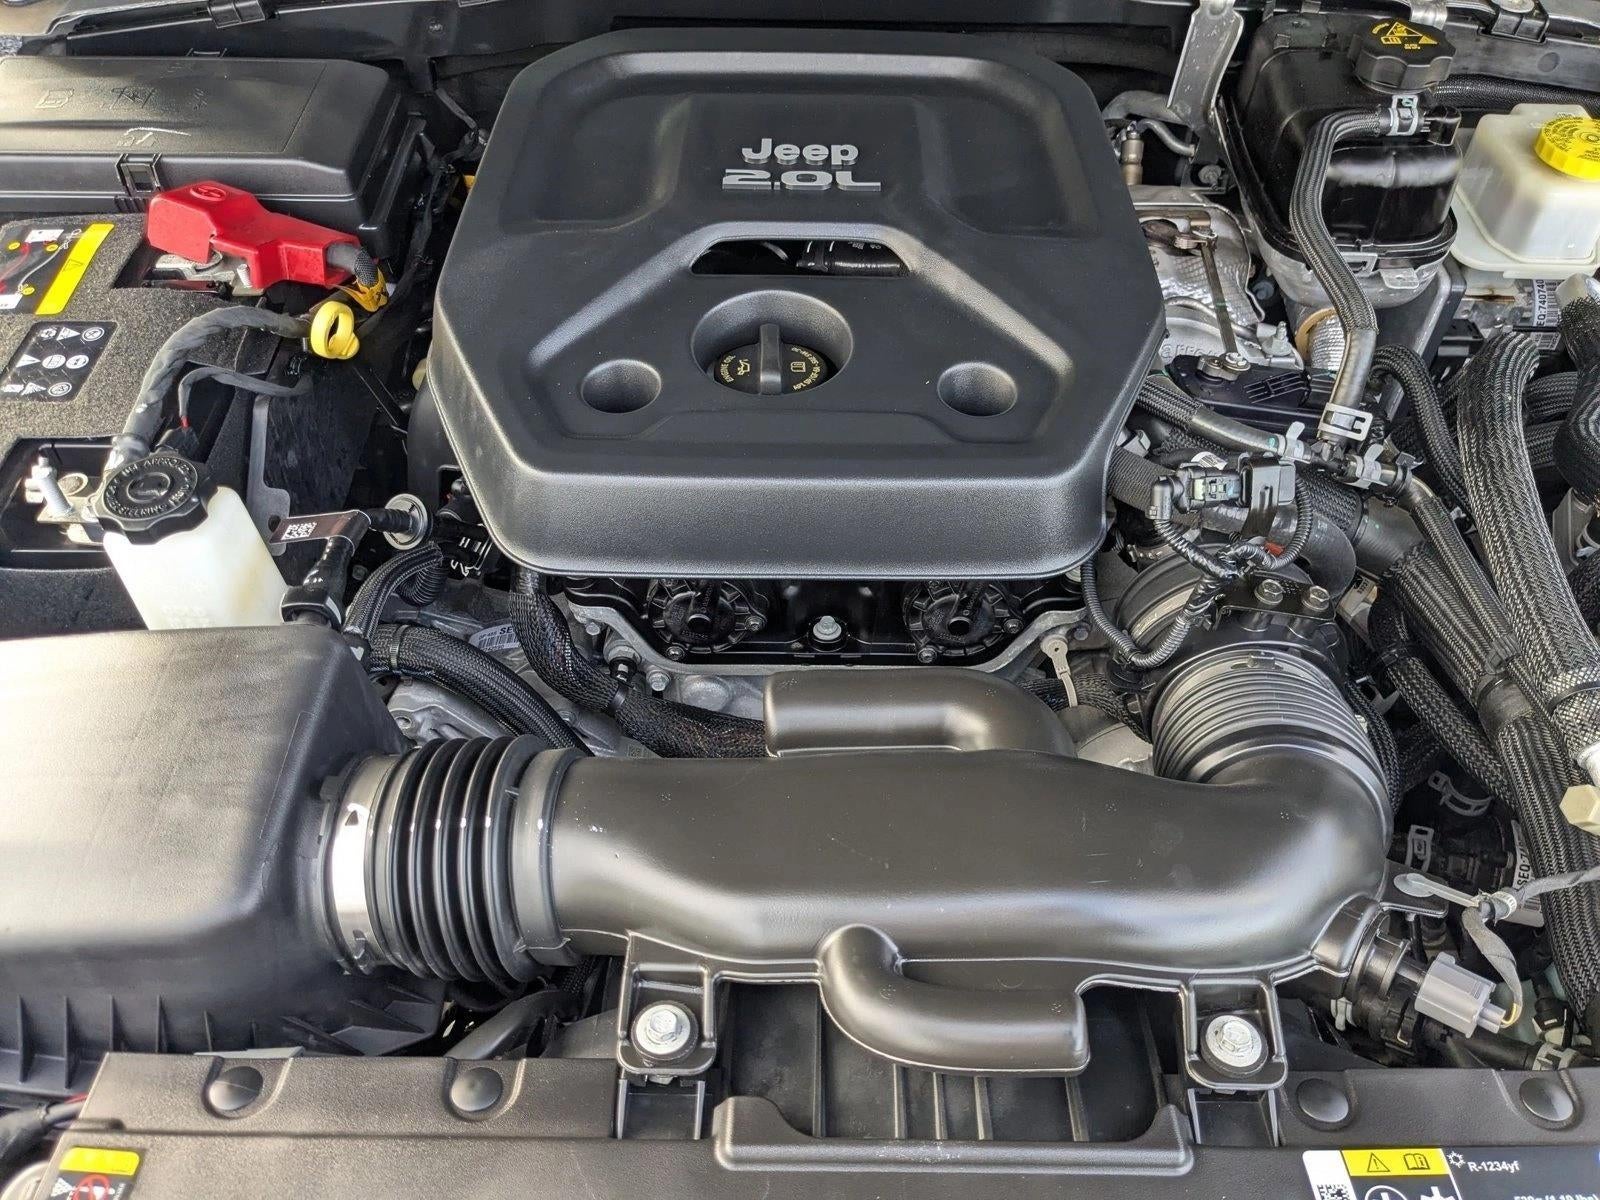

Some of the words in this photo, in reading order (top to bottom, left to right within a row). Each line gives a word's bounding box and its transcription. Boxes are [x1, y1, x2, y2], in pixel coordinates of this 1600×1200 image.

[741, 138, 859, 168] Jeep
[721, 168, 882, 191] 2.0L
[1535, 280, 1547, 327] EQ:740740
[1467, 1160, 1520, 1174] R-1234yf
